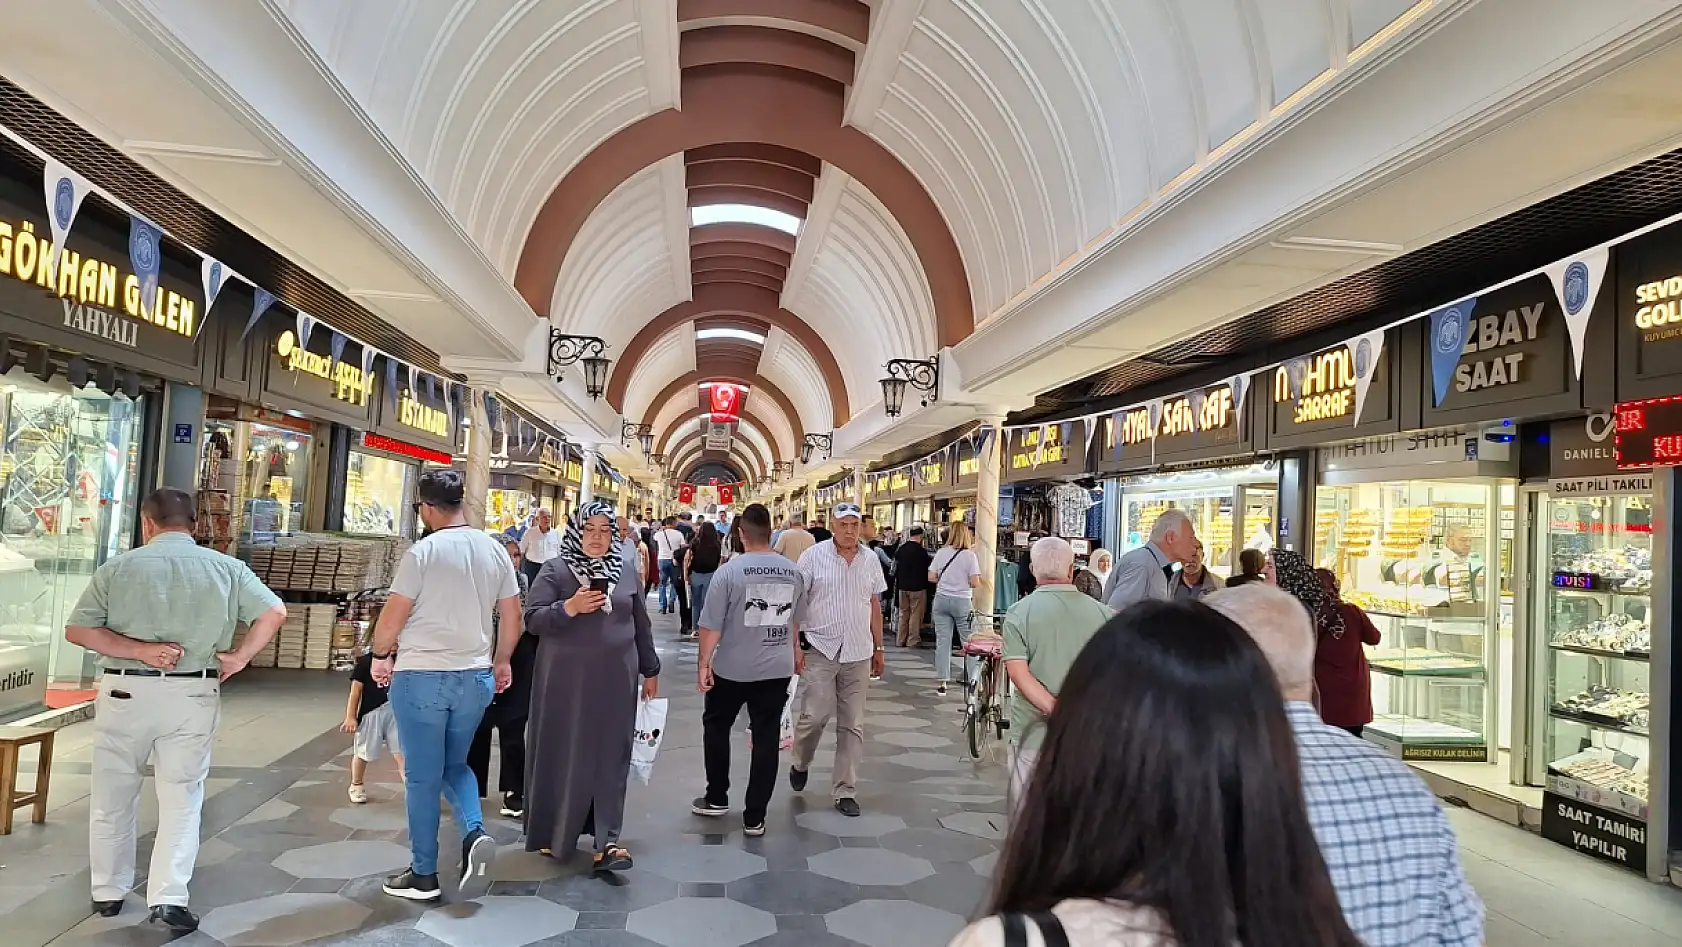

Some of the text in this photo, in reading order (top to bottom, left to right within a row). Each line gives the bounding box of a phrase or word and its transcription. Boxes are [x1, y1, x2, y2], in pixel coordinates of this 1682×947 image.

[62, 298, 139, 347] YAHYALI
[1462, 302, 1545, 354] ZBAY
[1635, 298, 1682, 329] GOL
[1644, 327, 1682, 342] KUYUMC
[1275, 348, 1357, 402] MHMU
[1455, 352, 1523, 393] SAAT
[1293, 388, 1350, 424] SARRAF
[1563, 447, 1610, 461] DANIEL
[1555, 481, 1584, 493] SAAT
[1587, 478, 1608, 492] PİLİ
[742, 566, 795, 577] BROOKLYN
[0, 668, 34, 692] rlidir
[1558, 803, 1644, 844] SAAT TAMİRİ
[1572, 830, 1626, 861] YAPILIR
